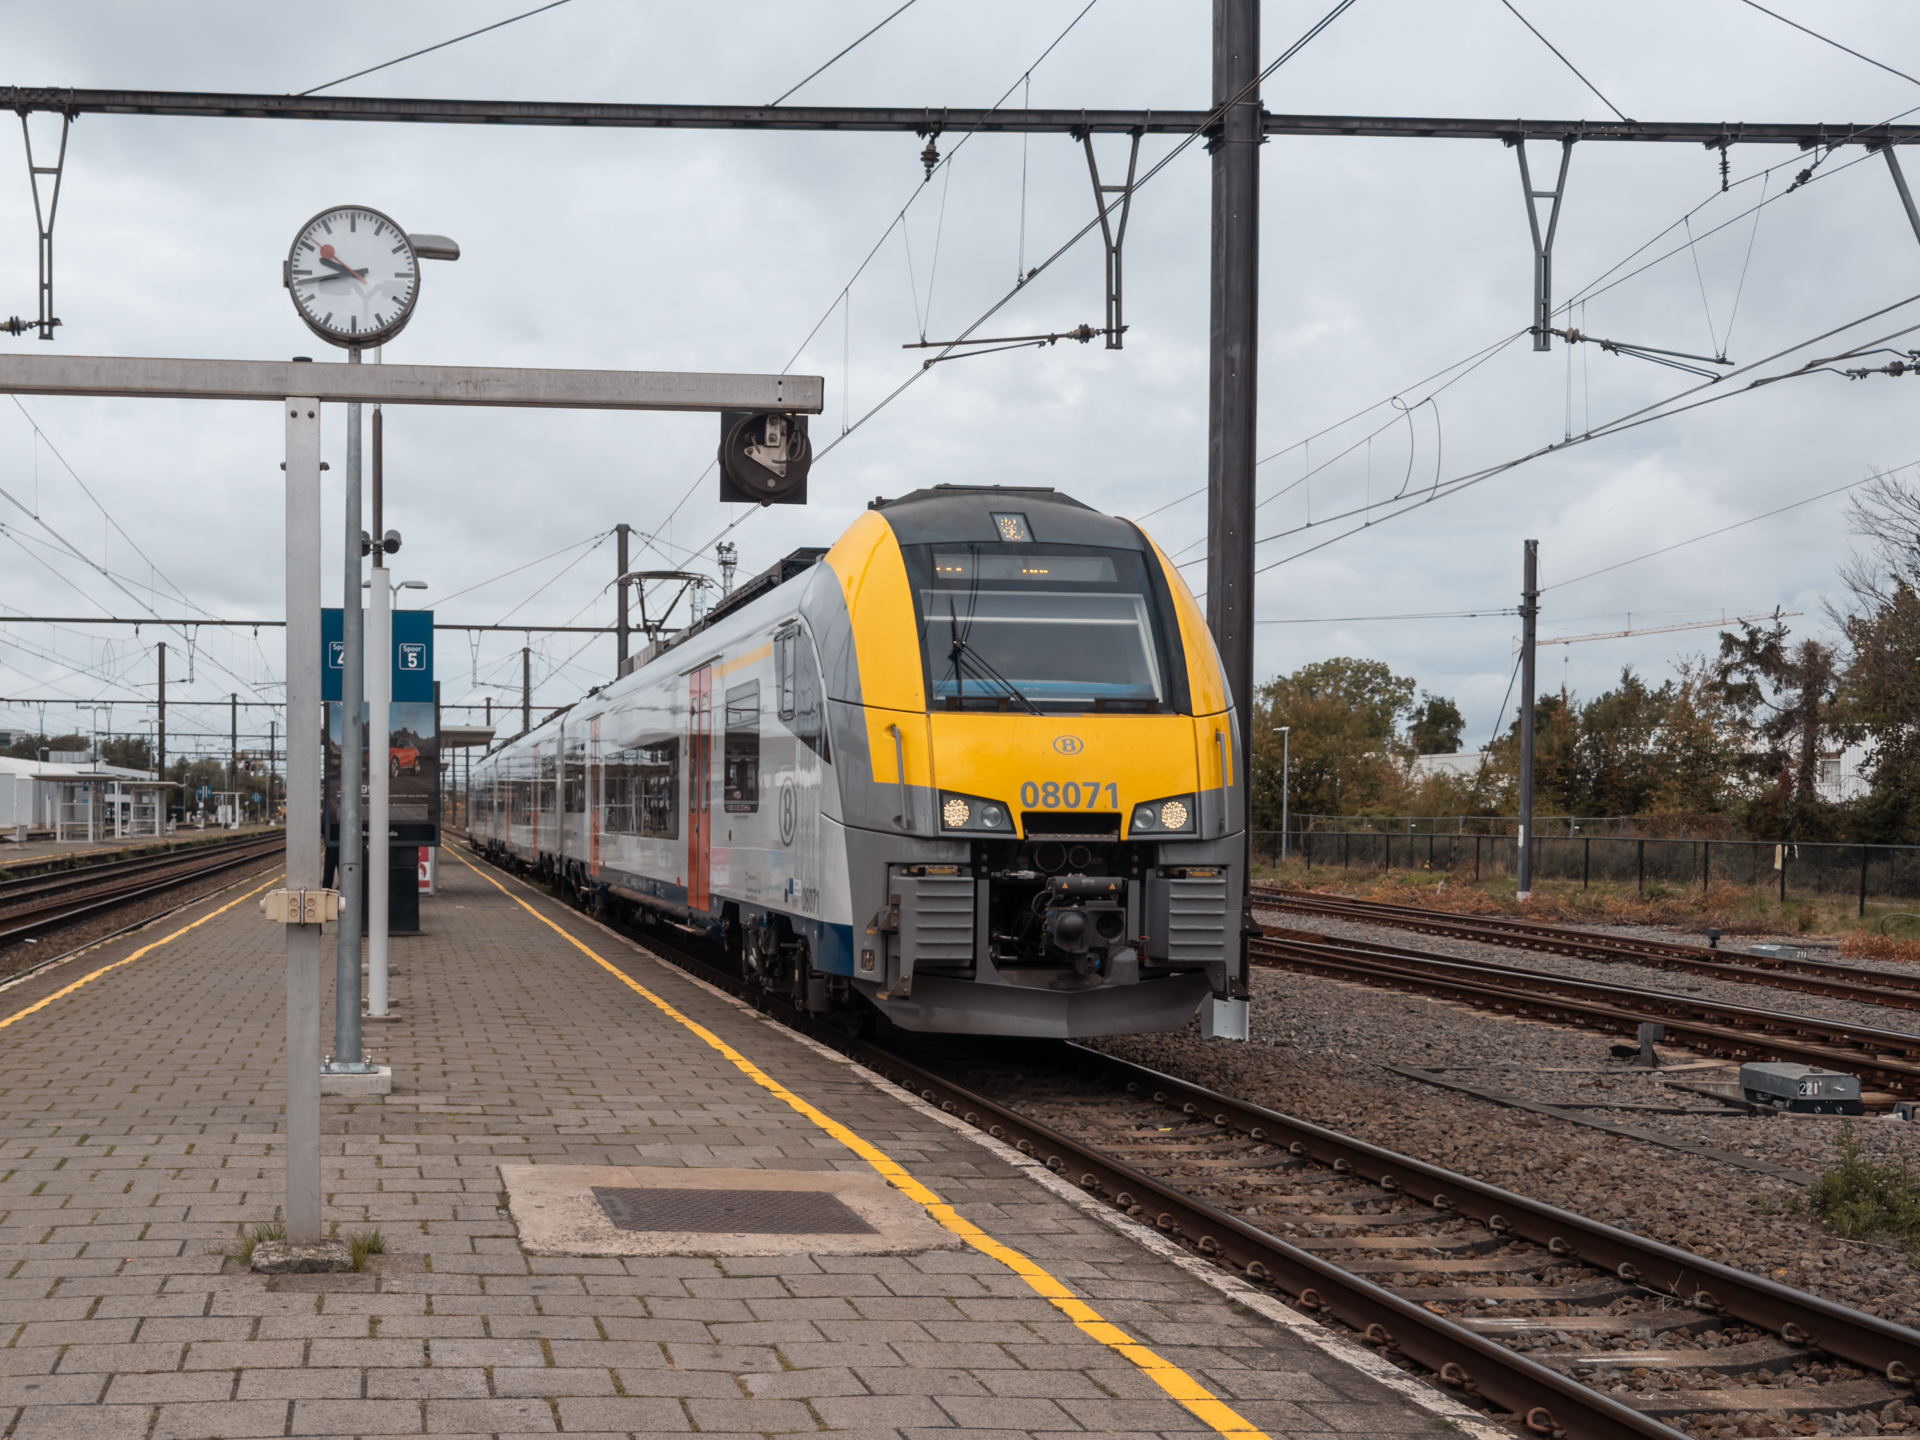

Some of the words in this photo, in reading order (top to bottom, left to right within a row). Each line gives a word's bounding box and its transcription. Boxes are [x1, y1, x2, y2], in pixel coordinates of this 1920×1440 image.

[403, 645, 422, 653] Spoor
[407, 653, 417, 668] 5
[1020, 780, 1118, 809] 08071
